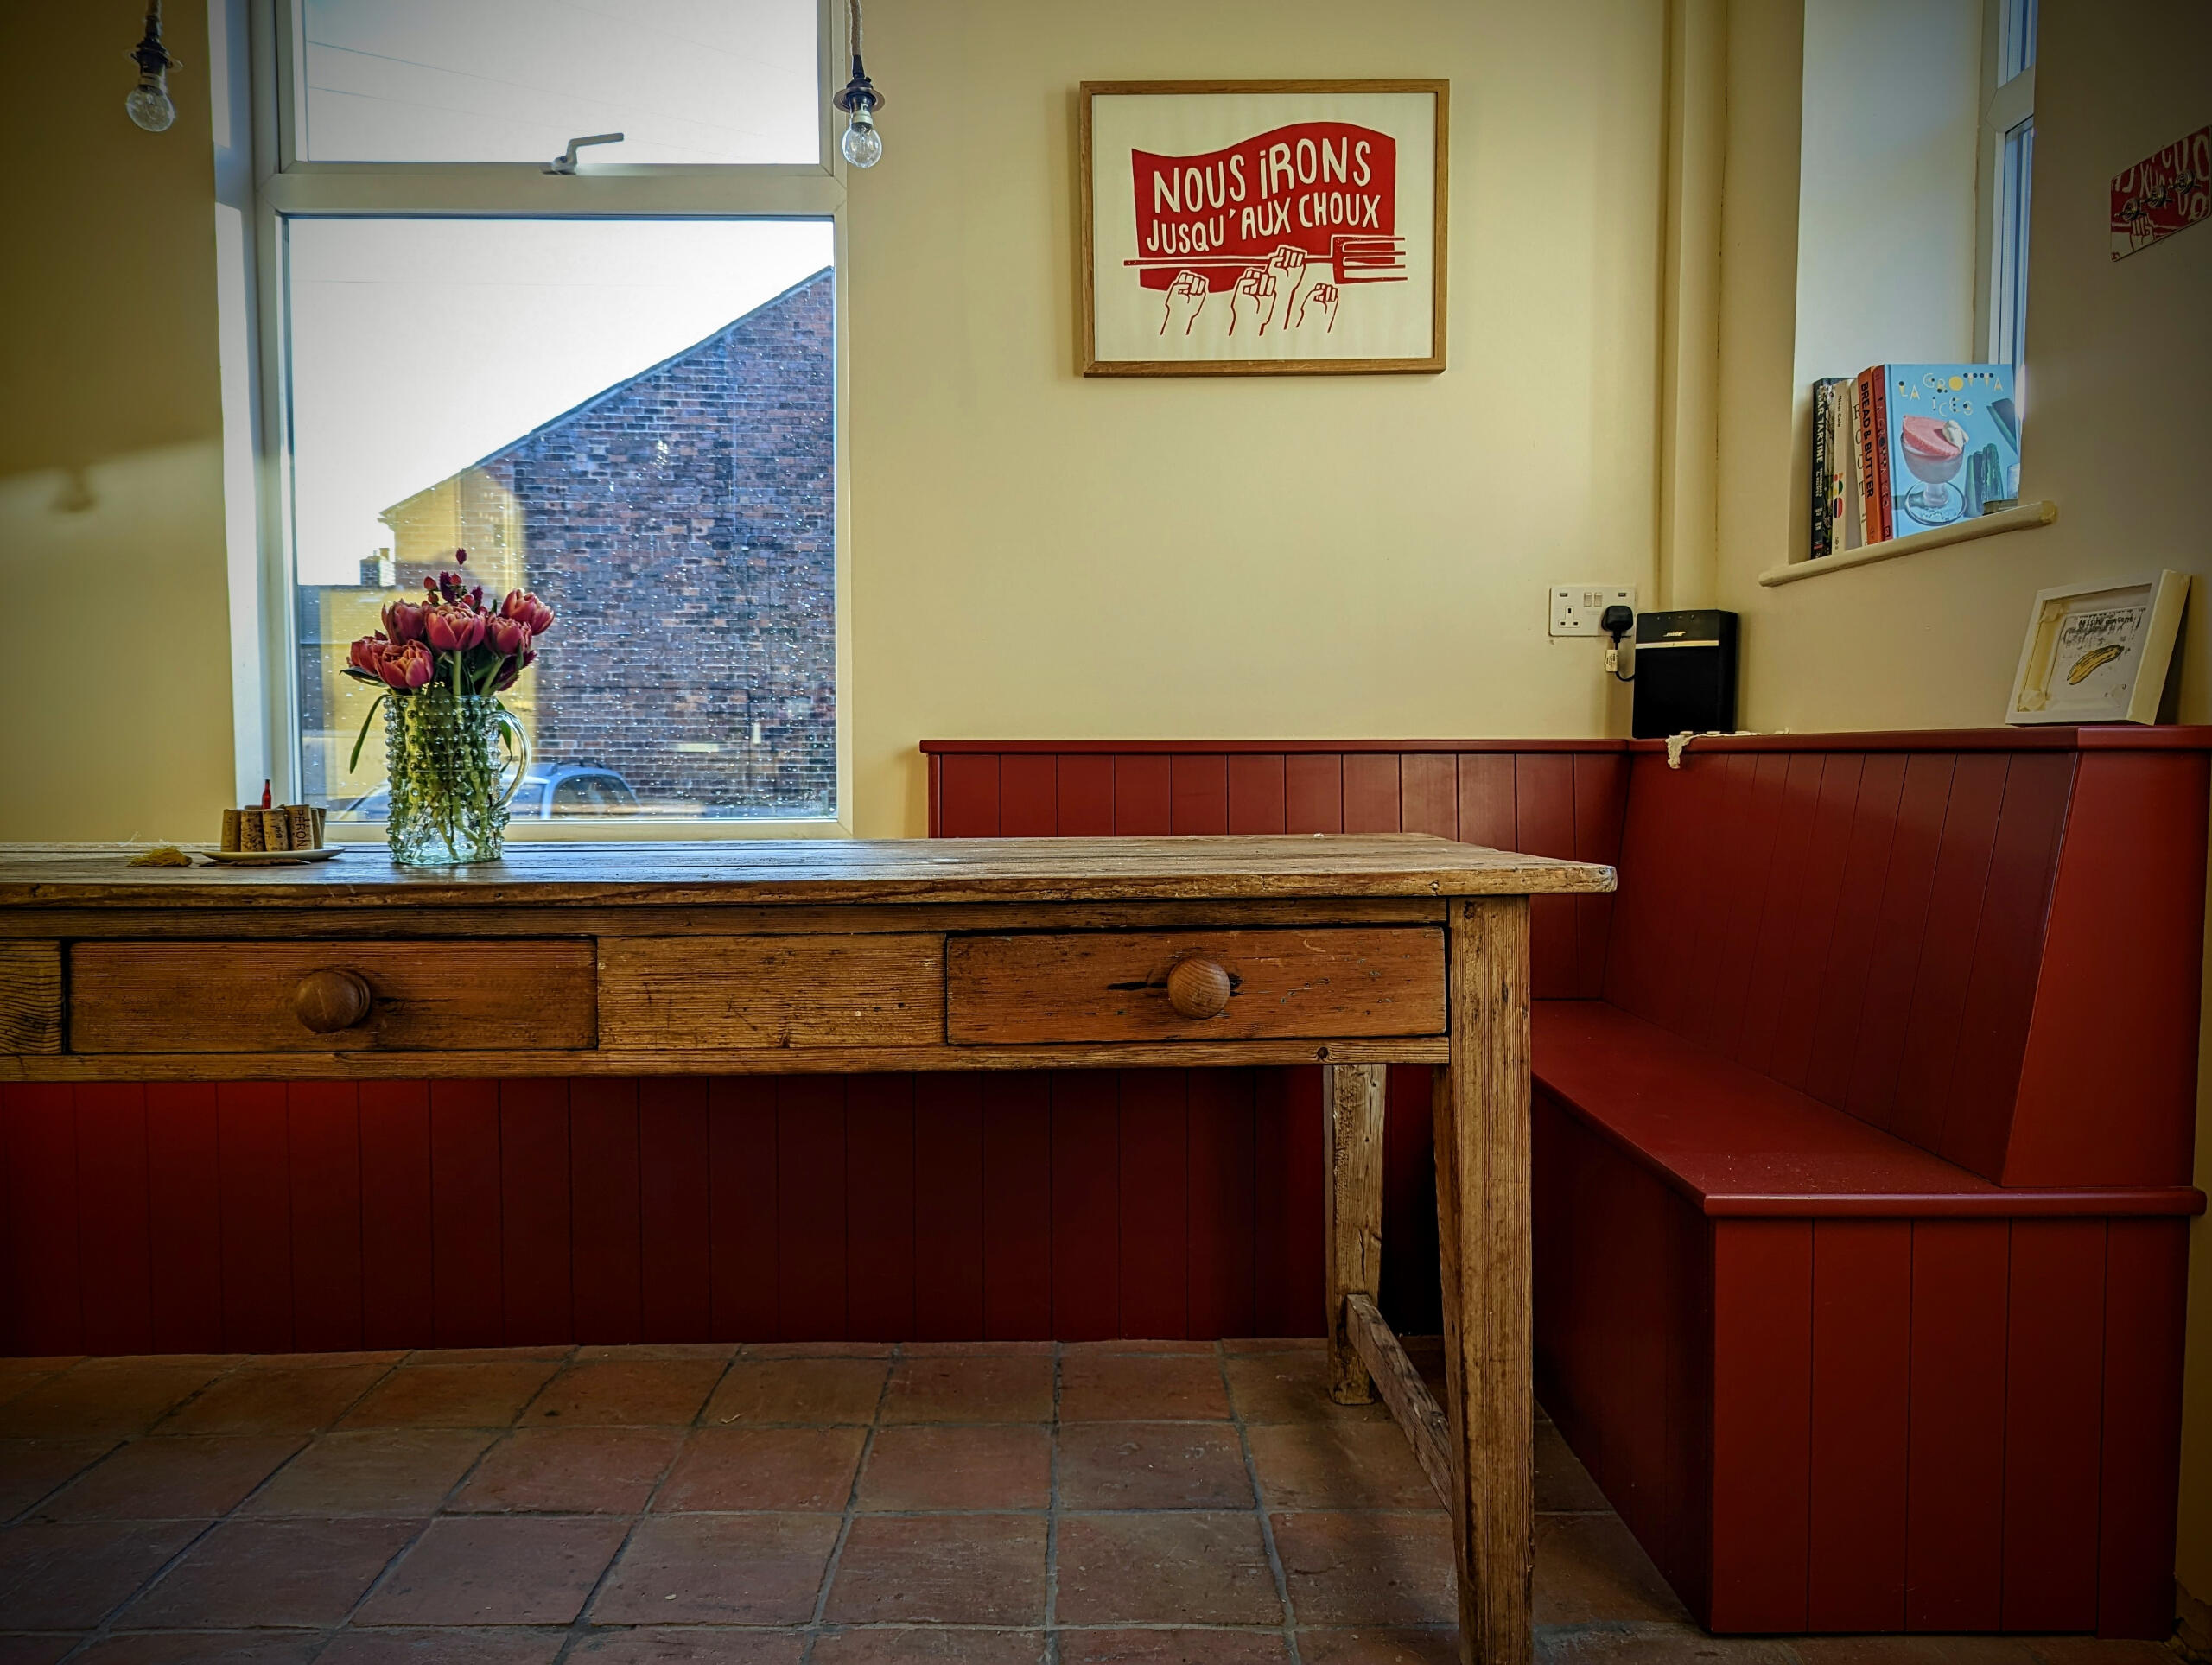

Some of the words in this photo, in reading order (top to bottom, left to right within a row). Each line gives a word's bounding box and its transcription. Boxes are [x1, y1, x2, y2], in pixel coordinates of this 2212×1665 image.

[1154, 154, 1246, 214] NOUS
[1146, 196, 1293, 255] JUSQU'AUX
[1298, 191, 1382, 229] CHOUX
[1861, 381, 1872, 429] BREAD
[1898, 381, 1922, 401] LA
[1923, 372, 2004, 393] GROTTA
[1932, 397, 1974, 417] ICES
[1816, 417, 1825, 463] TARTINE
[1863, 430, 1872, 441] &
[1864, 442, 1874, 499] BUTTER
